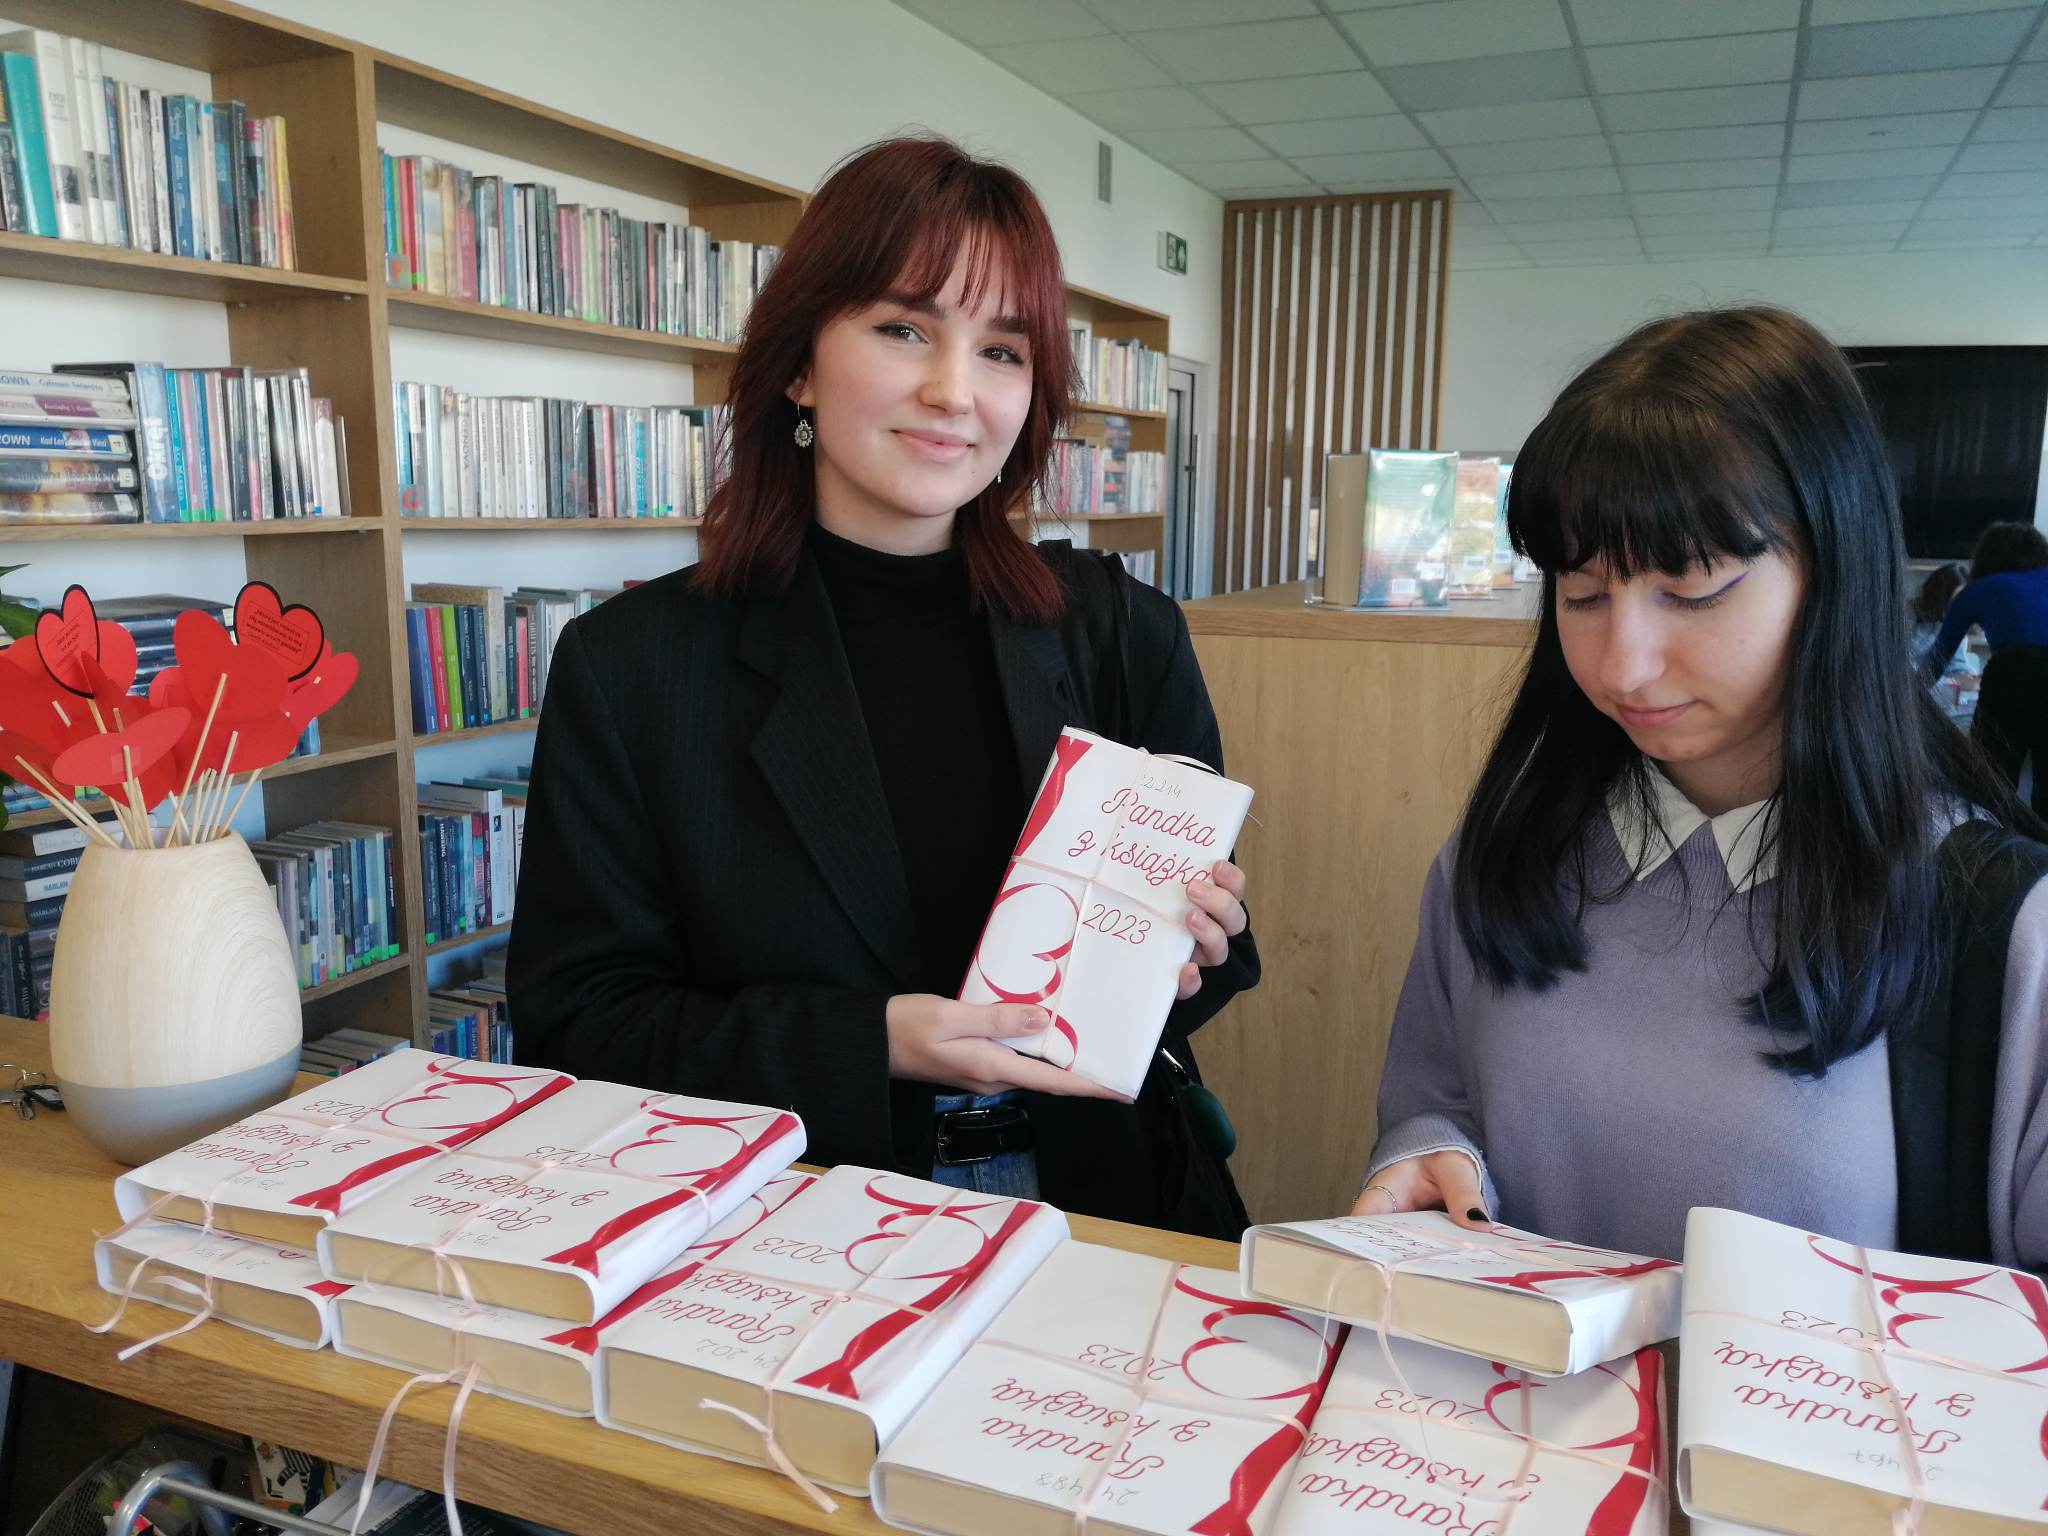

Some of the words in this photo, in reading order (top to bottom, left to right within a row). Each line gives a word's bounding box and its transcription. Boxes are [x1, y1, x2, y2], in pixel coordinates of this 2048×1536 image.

[1082, 903, 1152, 945] 2023
[752, 1236, 848, 1264] 2023
[1934, 1392, 1976, 1418] z
